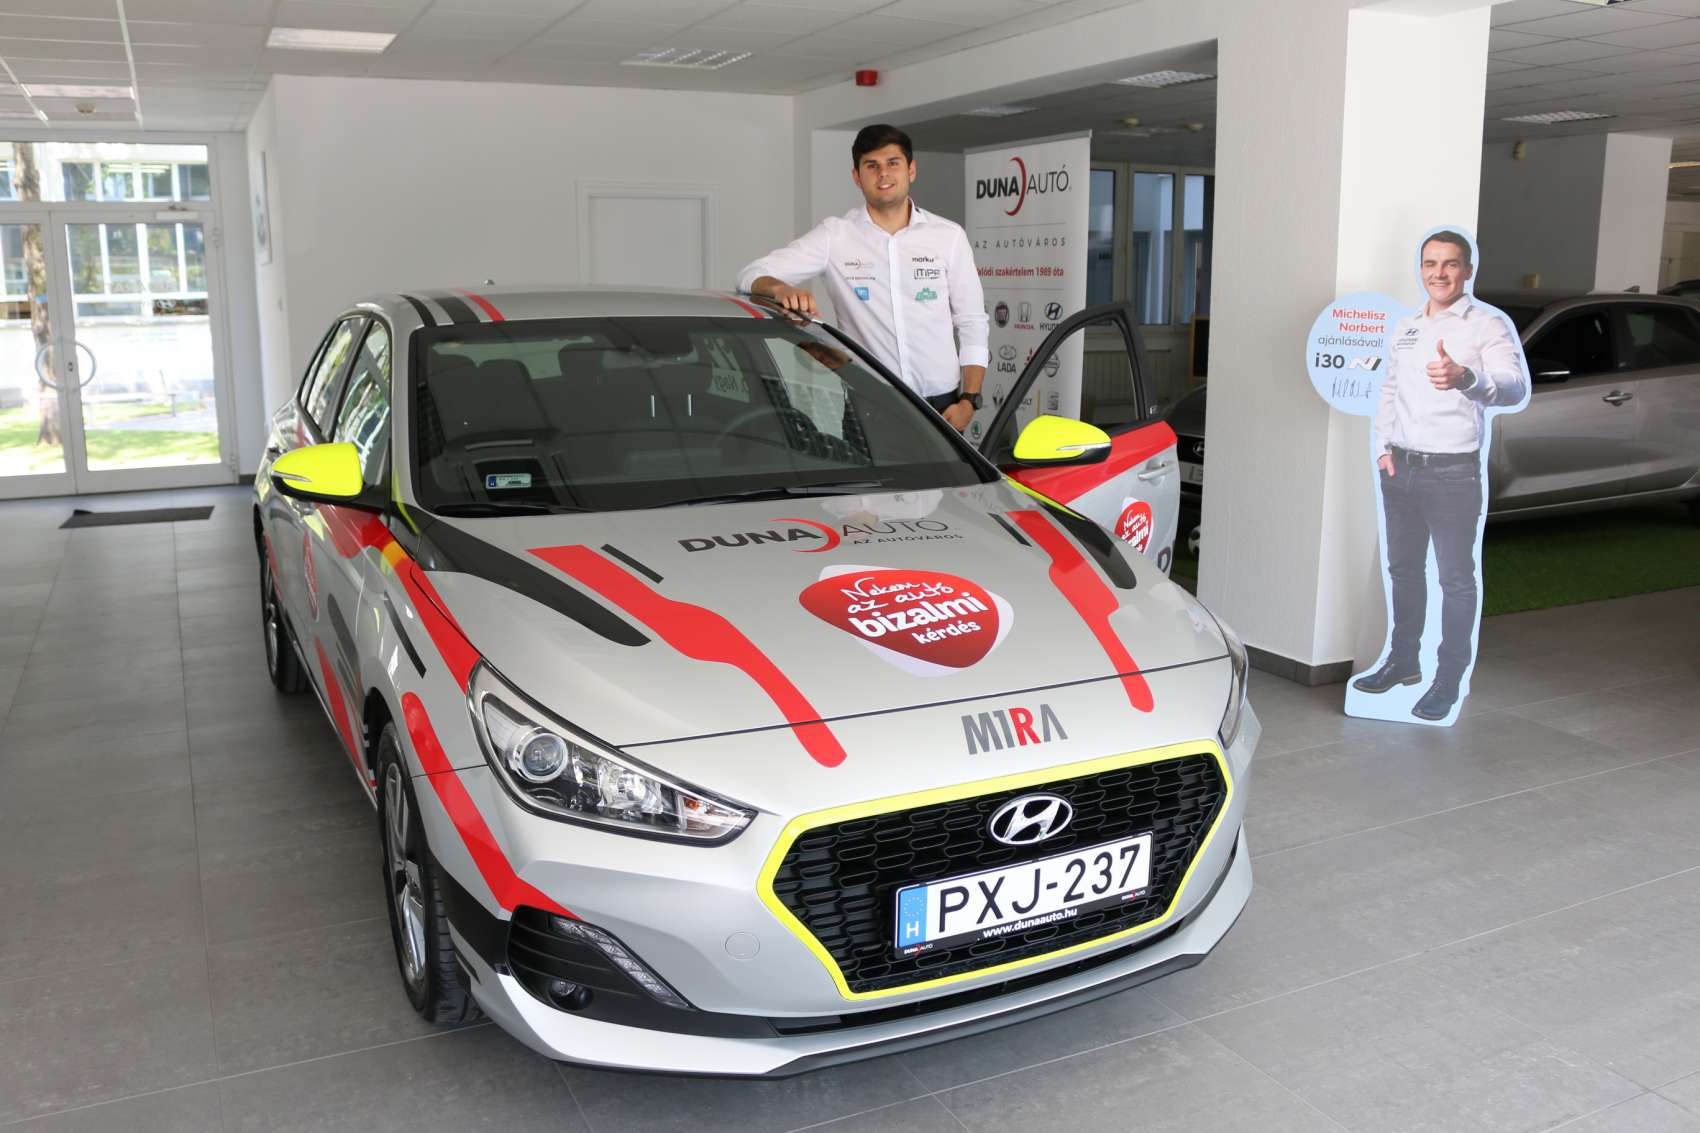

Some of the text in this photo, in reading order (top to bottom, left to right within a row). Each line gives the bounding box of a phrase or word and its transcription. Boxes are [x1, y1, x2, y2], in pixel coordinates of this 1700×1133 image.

[976, 164, 1069, 199] DUNA AUTÓ
[975, 237, 1066, 249] AZ AUTÓVÁROS
[995, 266, 1034, 277] szakértelem
[1332, 309, 1386, 321] Michelisz
[1339, 323, 1385, 334] Norbert
[1317, 336, 1384, 348] ajánlásával!
[997, 362, 1017, 373] LADA
[1315, 352, 1345, 369] i30
[677, 515, 949, 553] DUNA AUTÓ
[852, 536, 873, 546] AZ
[840, 576, 921, 602] Nekem
[846, 580, 954, 615] az autó
[847, 591, 988, 639] bizalmi
[911, 618, 982, 645] kérdés
[938, 843, 1141, 933] PXJ-237
[906, 920, 920, 939] H
[983, 907, 1078, 939] www.dunaauto.hu
